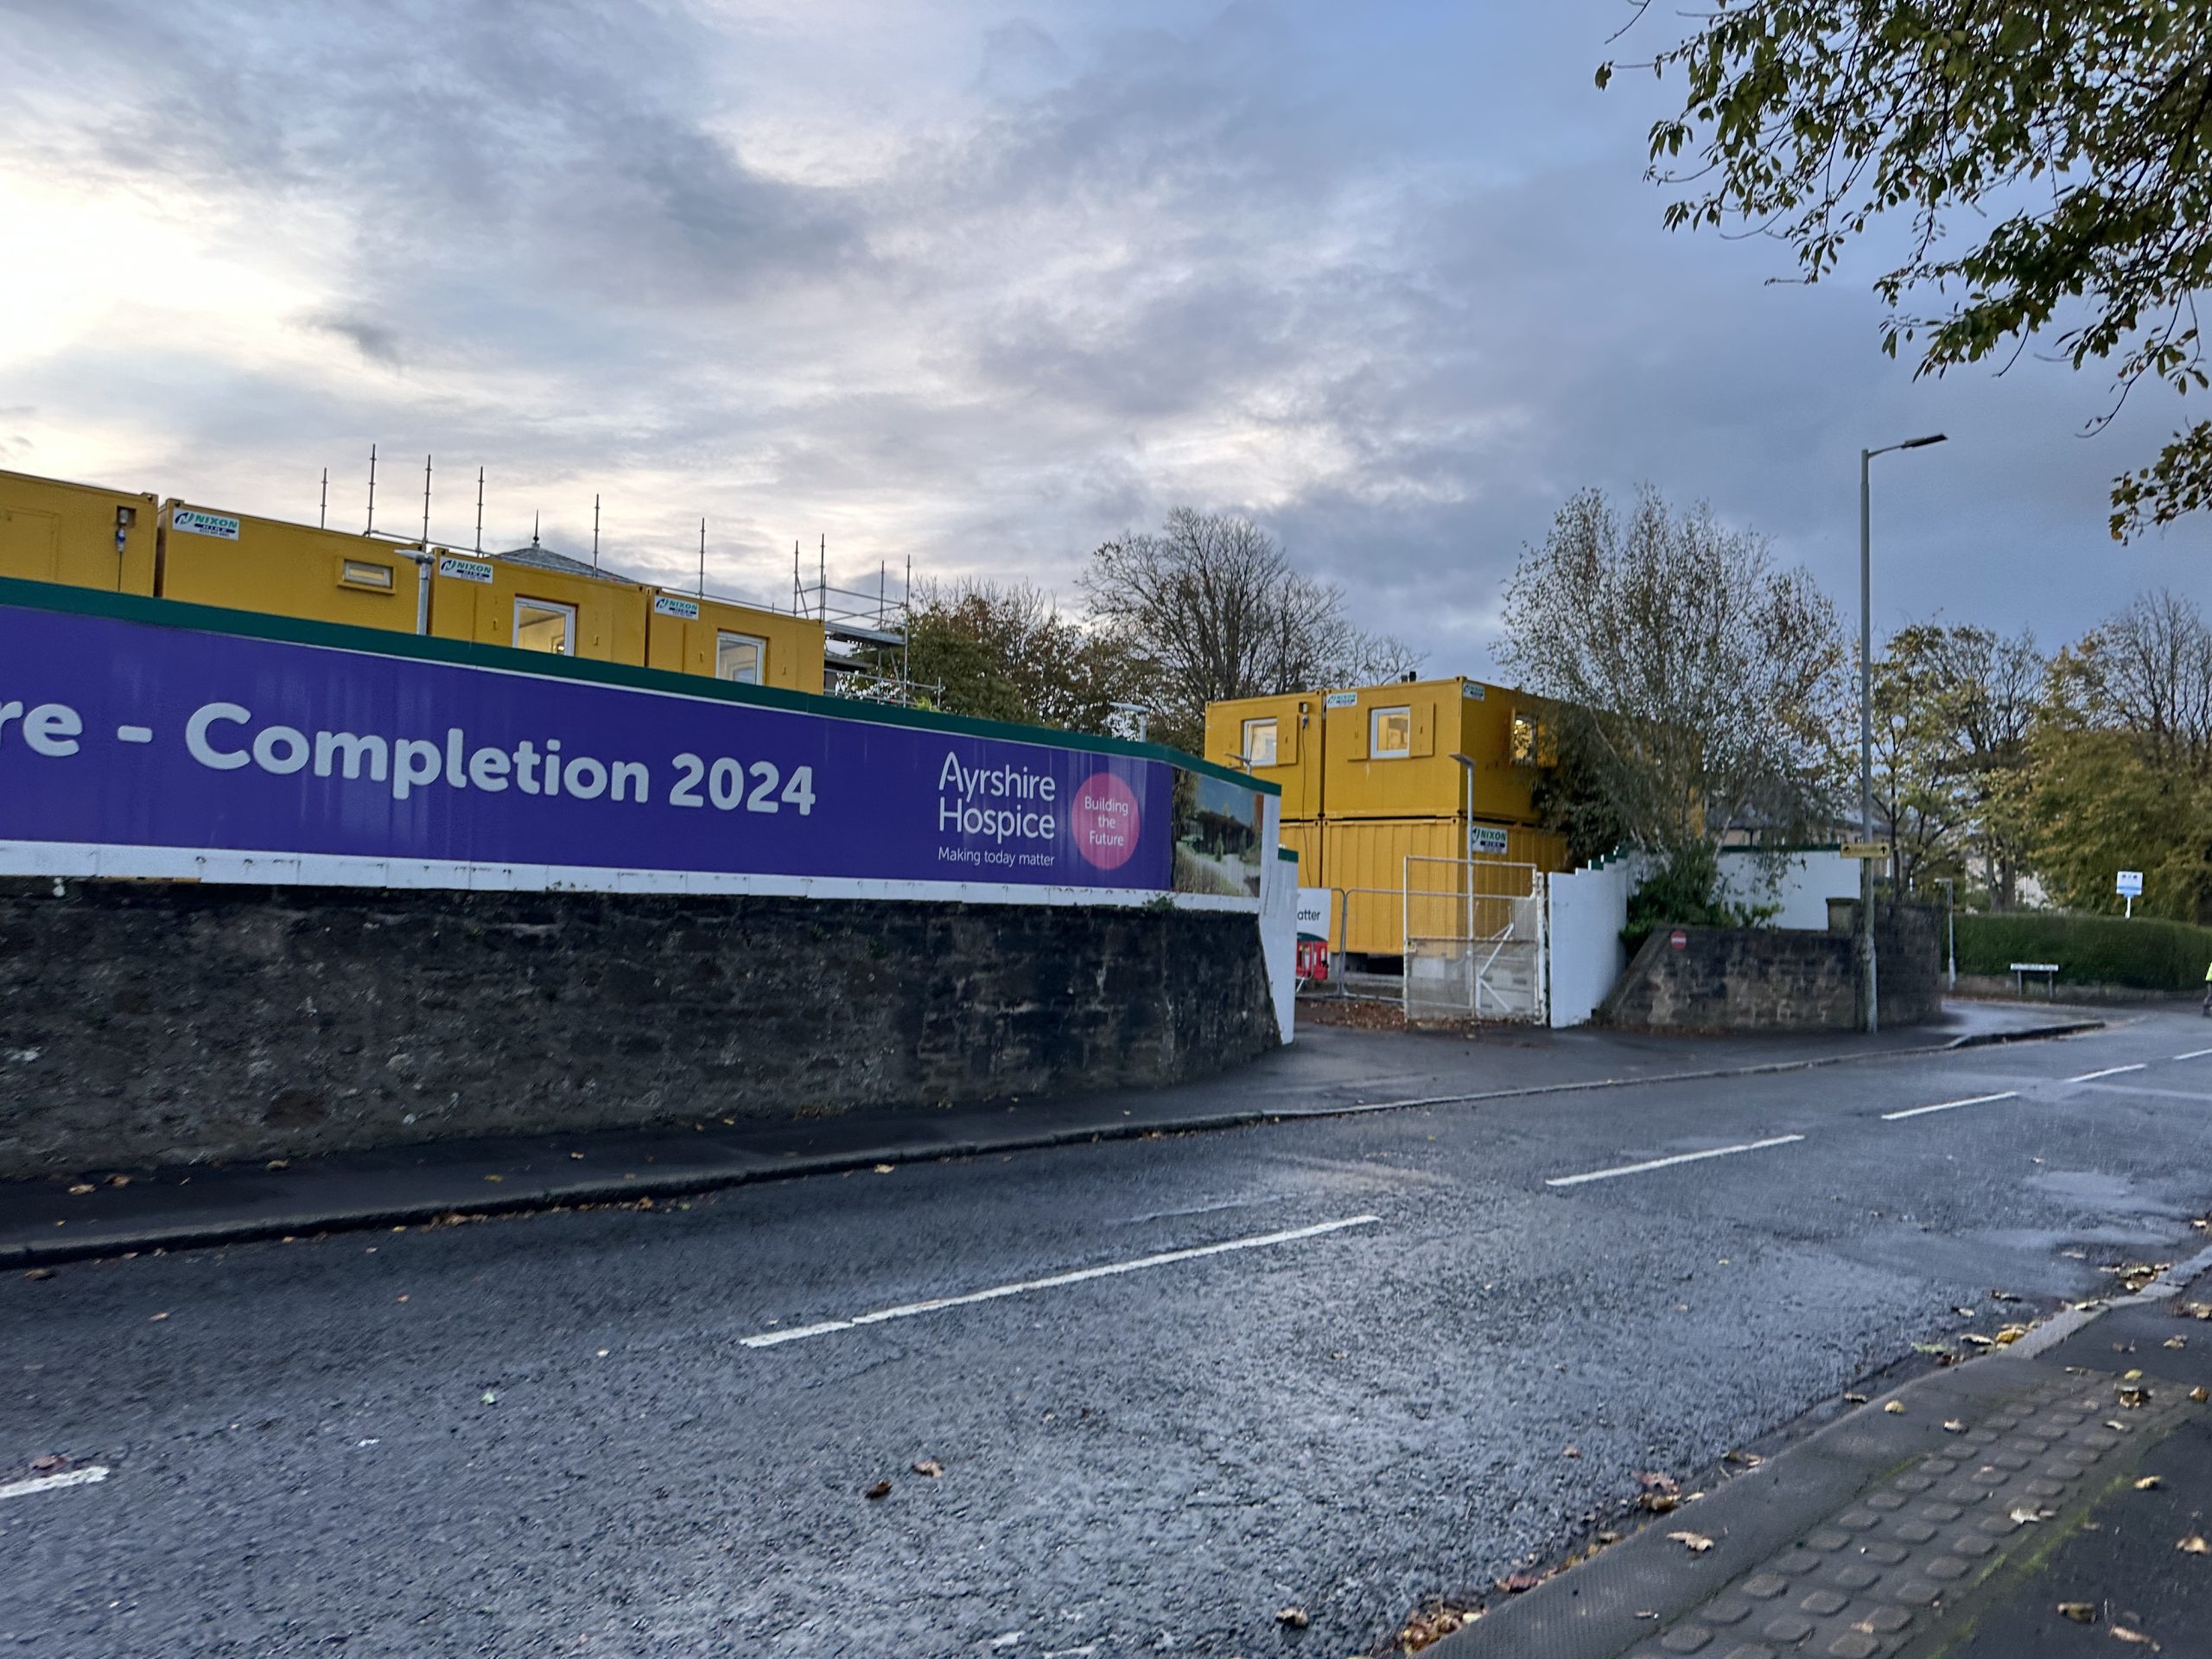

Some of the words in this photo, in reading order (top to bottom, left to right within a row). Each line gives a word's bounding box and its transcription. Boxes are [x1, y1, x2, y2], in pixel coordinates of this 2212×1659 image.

[195, 514, 238, 528] NIXON
[457, 562, 492, 573] NIXON
[669, 601, 698, 610] NIXON
[185, 702, 650, 804] Completion
[669, 753, 817, 816] 2024
[938, 751, 1056, 803] Ayrshire
[1084, 797, 1128, 816] Building
[938, 797, 1056, 844] Hospice
[1098, 815, 1116, 830] the
[1089, 830, 1124, 847] Future
[1480, 830, 1507, 841] NIXON
[938, 846, 981, 866] Making
[984, 848, 1015, 868] today
[1019, 853, 1055, 867] matter
